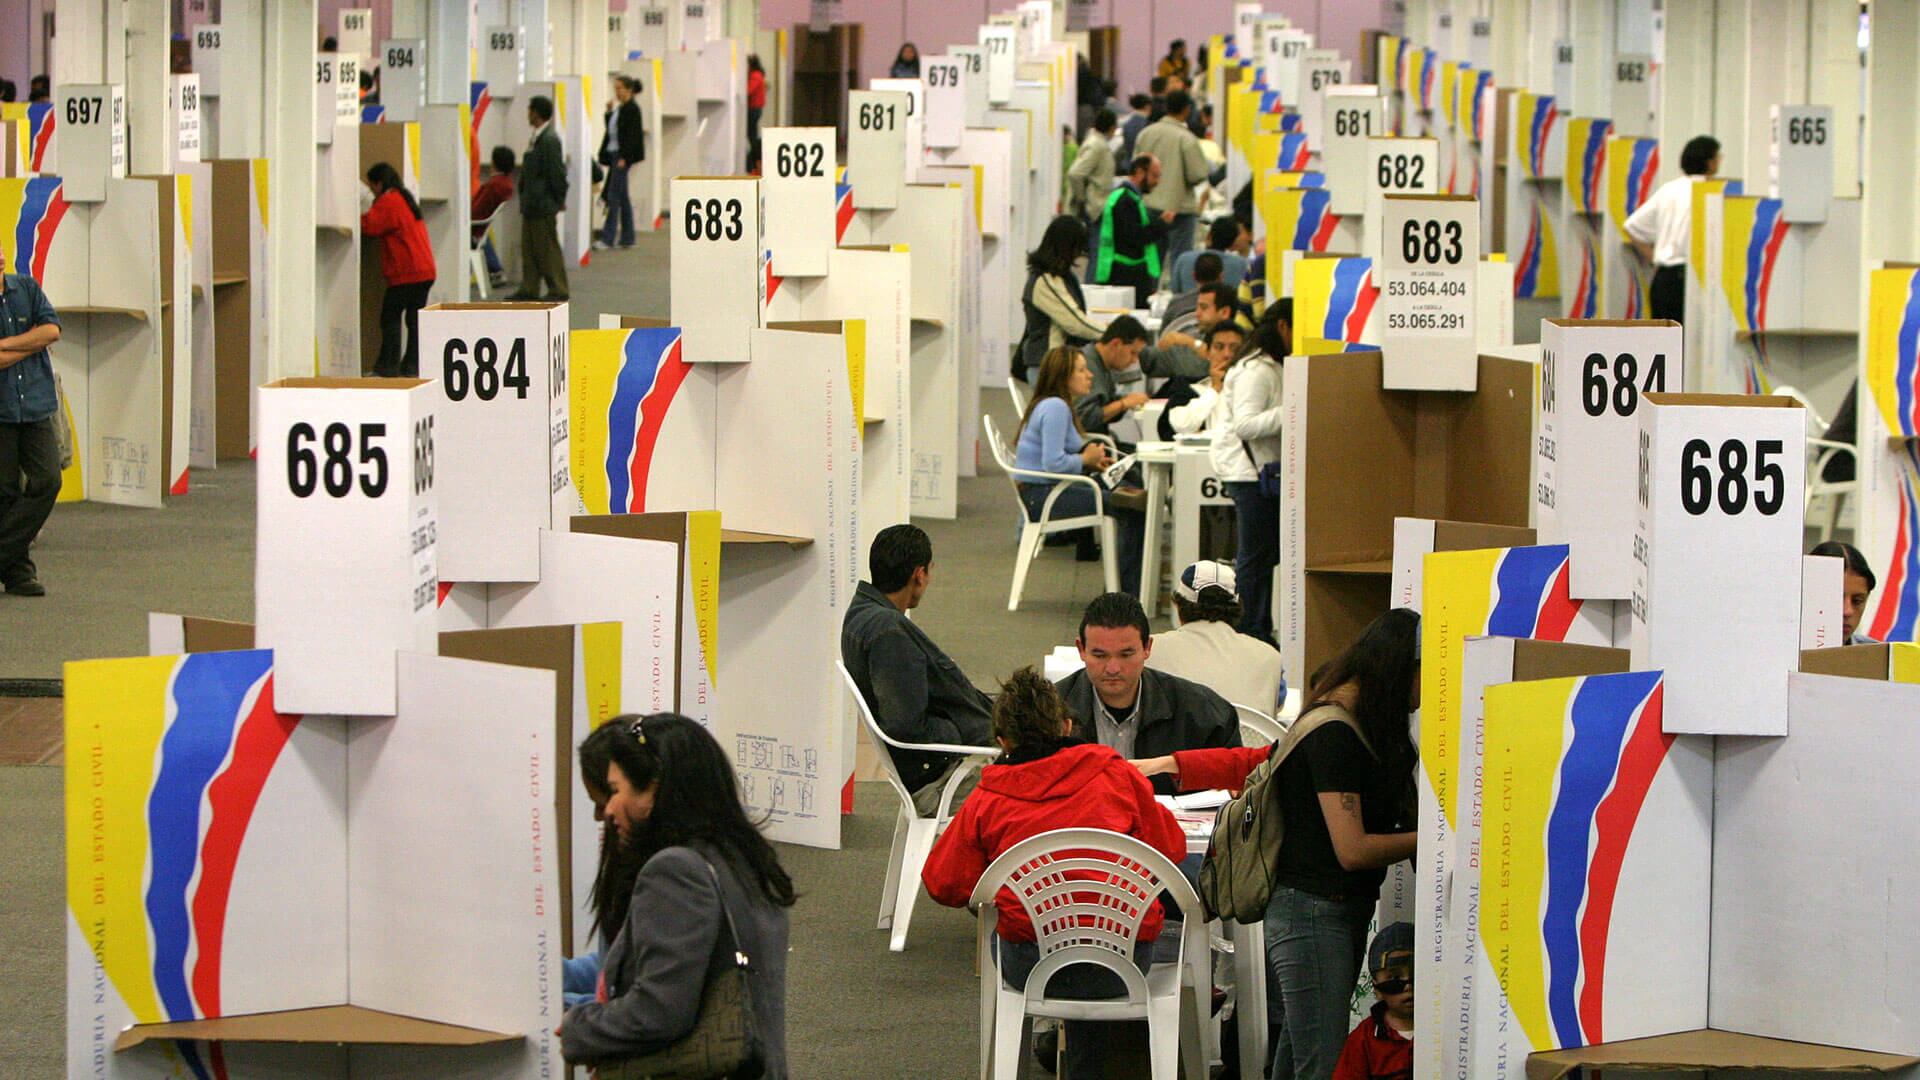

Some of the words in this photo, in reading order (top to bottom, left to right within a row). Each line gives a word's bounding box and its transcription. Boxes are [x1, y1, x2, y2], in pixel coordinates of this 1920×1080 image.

[198, 31, 221, 48] 693
[388, 48, 414, 68] 694
[490, 33, 514, 50] 693
[340, 62, 356, 84] 695
[928, 65, 958, 87] 679
[1617, 62, 1644, 82] 662
[66, 97, 102, 124] 697
[182, 85, 196, 110] 696
[860, 104, 896, 131] 681
[1336, 110, 1371, 136] 681
[1790, 118, 1826, 144] 665
[777, 142, 825, 178] 682
[1378, 154, 1425, 189] 682
[685, 198, 742, 242] 683
[1402, 219, 1462, 264] 683
[1388, 281, 1466, 296] 53.064.404
[1388, 314, 1464, 328] 53.065.291
[444, 337, 530, 402] 684
[552, 331, 566, 399] 684
[1542, 348, 1556, 414] 684
[1582, 353, 1666, 417] 684
[287, 422, 389, 498] 685
[414, 414, 435, 496] 685
[1680, 438, 1785, 516] 685
[700, 575, 709, 612] CIVIL
[1404, 582, 1412, 604] VIL
[653, 610, 661, 648] CIVIL
[698, 618, 708, 672] ESTADO
[1440, 620, 1448, 659] CIVIL
[698, 678, 706, 705] DEL
[1439, 666, 1448, 721] ESTADO
[1475, 716, 1484, 756] CIVIL
[93, 744, 104, 789] CIVIL
[531, 752, 540, 799] CIVIL
[1437, 768, 1447, 842] NACIONAL
[1472, 766, 1483, 828] ESTADO
[1504, 766, 1513, 812] CIVIL
[94, 795, 105, 865] ESTADO
[532, 806, 542, 873] ESTADO
[1470, 838, 1480, 868] DEL
[1501, 822, 1512, 889] ESTADO
[94, 870, 105, 906] DEL
[535, 883, 545, 916] DEL
[1394, 864, 1403, 909] REGIST
[1434, 850, 1444, 962] REGISTRADURIA
[1464, 882, 1479, 965] NACIONAL
[1500, 898, 1509, 932] DEL
[95, 918, 106, 1004] NACIONAL
[536, 928, 548, 1017] NACIONAL
[1498, 944, 1510, 1033] NACIONAL
[1458, 974, 1473, 1080] GISTRADURIA
